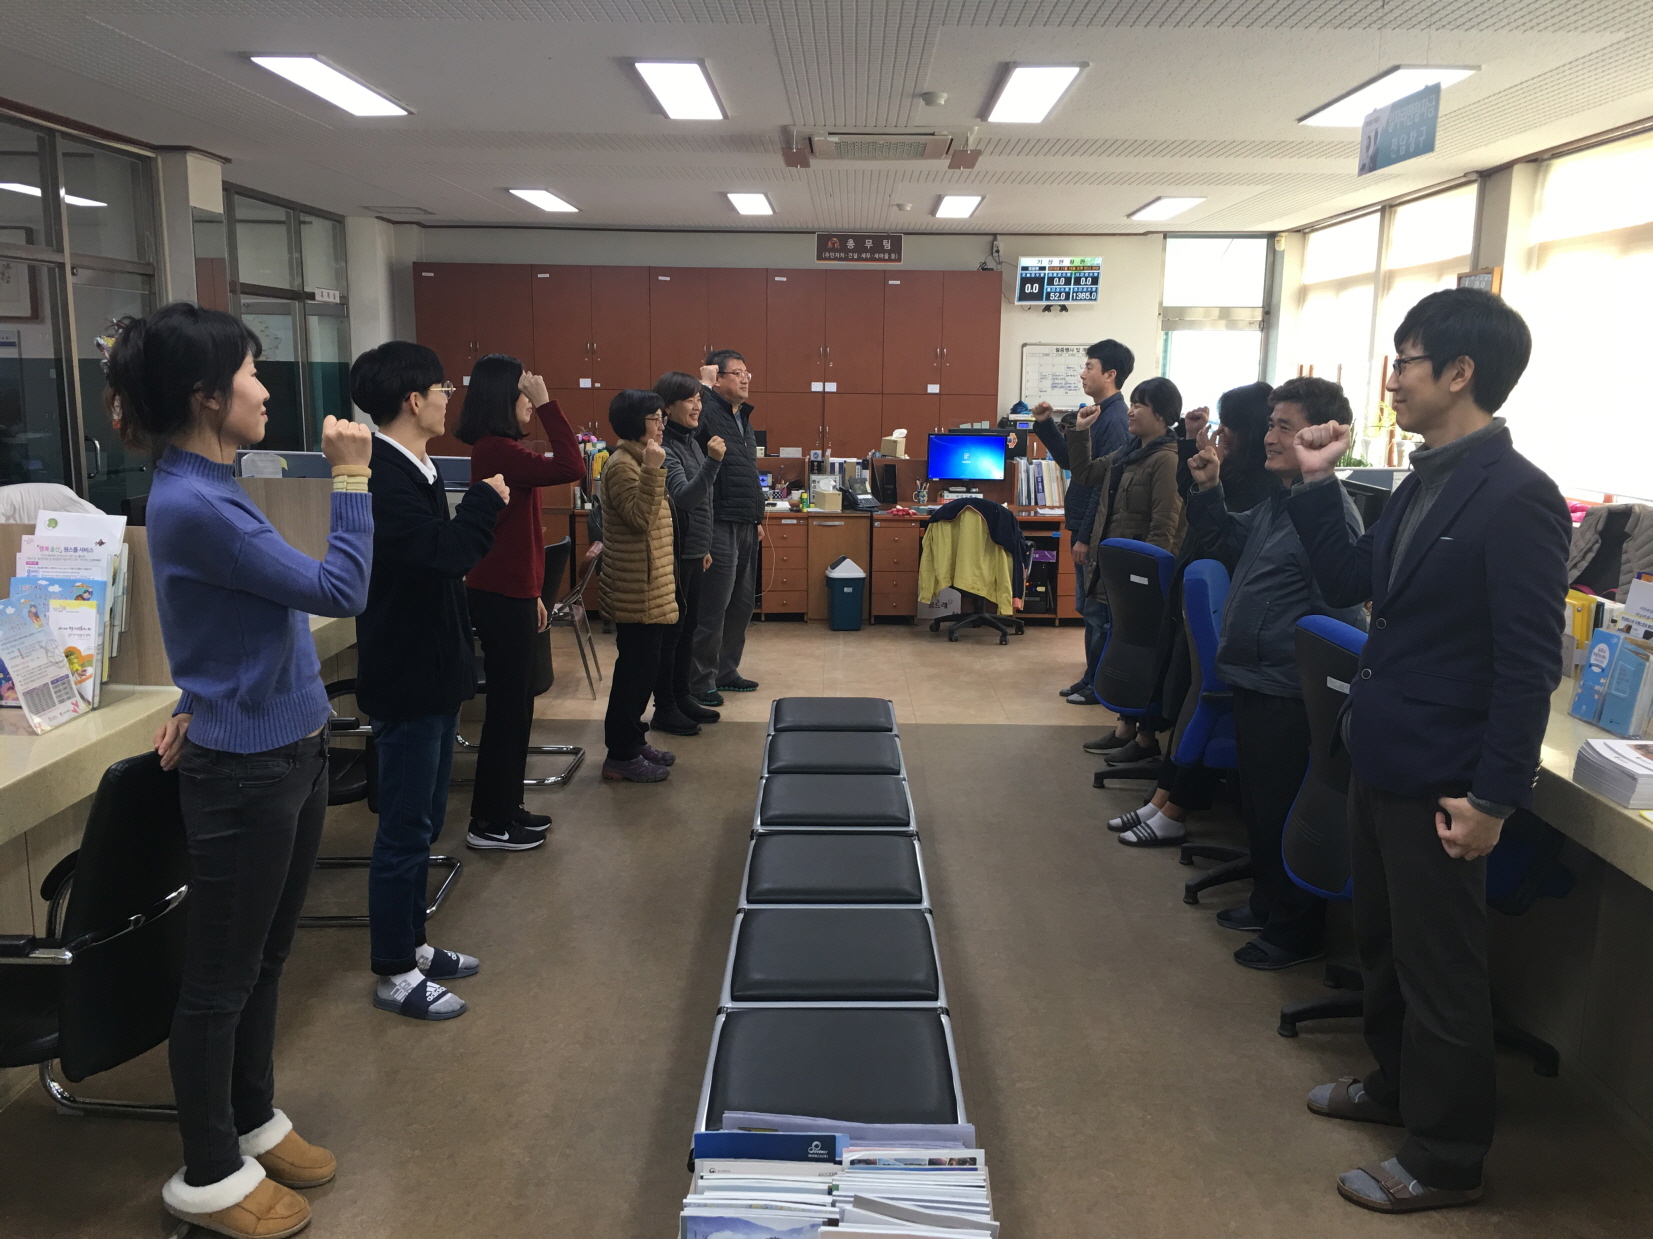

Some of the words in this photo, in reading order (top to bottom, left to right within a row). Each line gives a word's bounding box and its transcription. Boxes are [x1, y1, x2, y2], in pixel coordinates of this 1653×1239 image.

[1053, 277, 1065, 285] 0.0
[1080, 277, 1092, 285] 0.0
[1024, 283, 1039, 293] 0.0
[1049, 292, 1066, 300] 52.0
[1072, 292, 1097, 300] 1365.0
